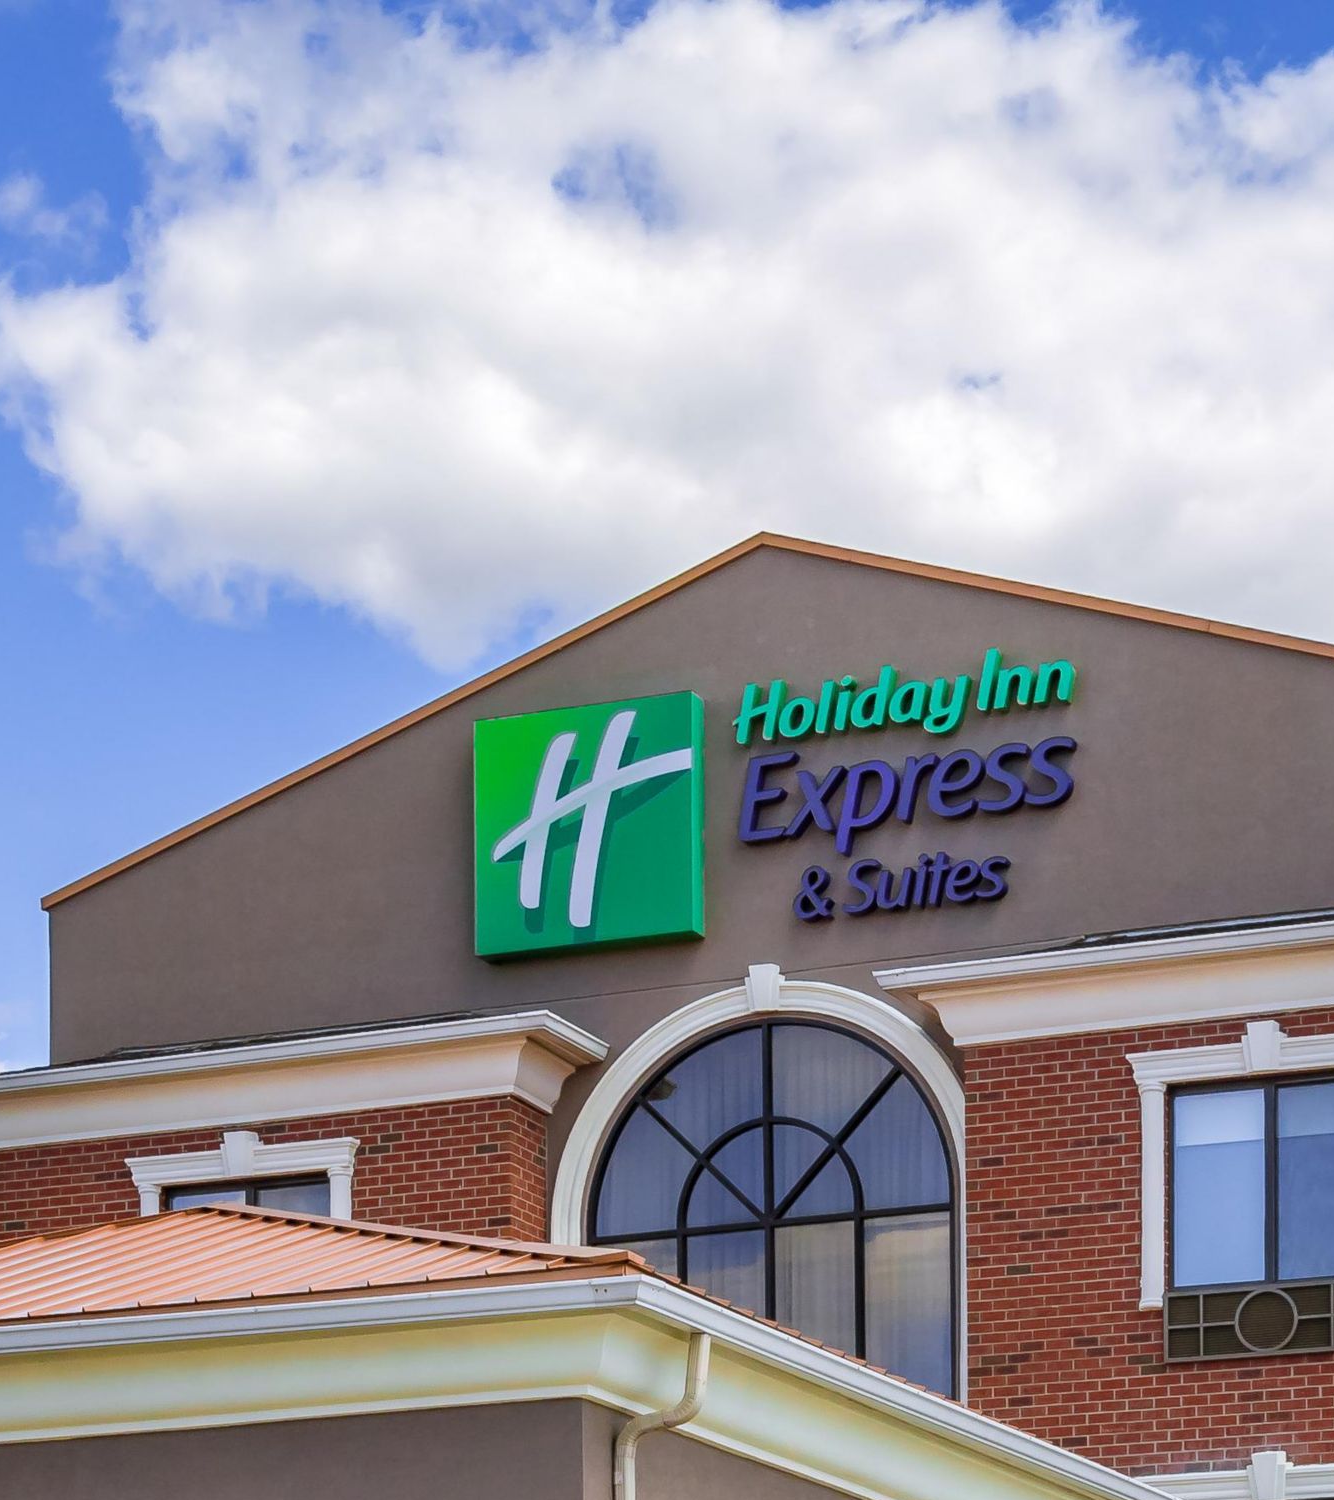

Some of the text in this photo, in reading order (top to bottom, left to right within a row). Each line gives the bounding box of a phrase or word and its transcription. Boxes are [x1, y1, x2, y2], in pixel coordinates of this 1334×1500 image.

[733, 648, 1076, 745] Holiday Inn
[739, 736, 1078, 856] Express
[793, 853, 1011, 923] & Suites
